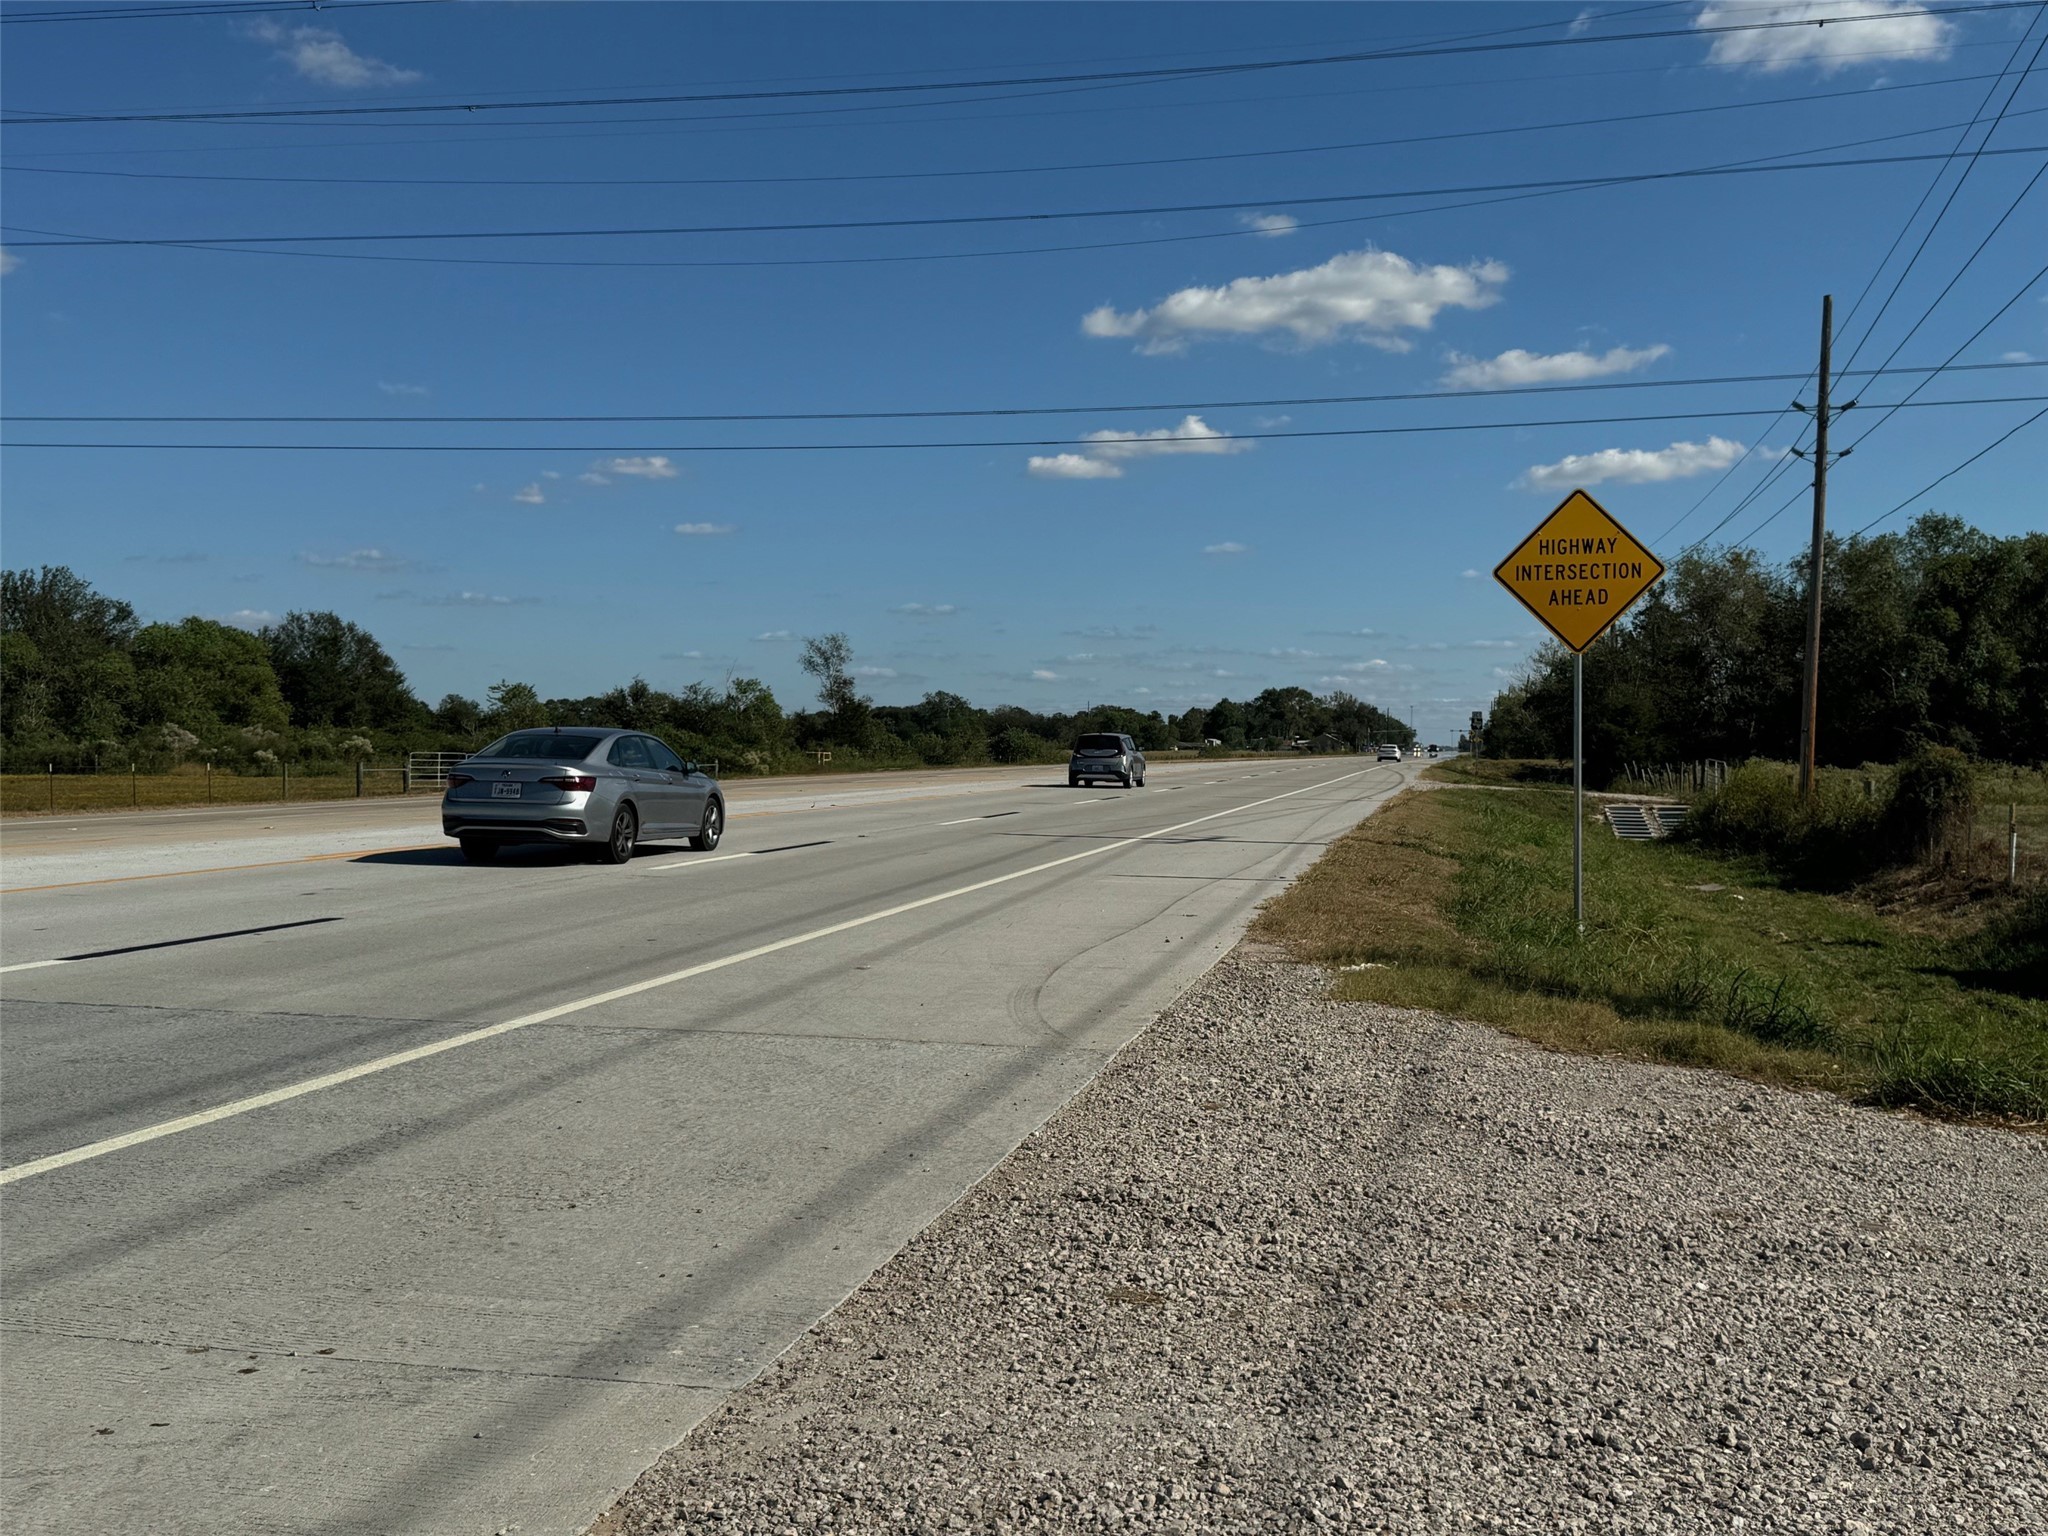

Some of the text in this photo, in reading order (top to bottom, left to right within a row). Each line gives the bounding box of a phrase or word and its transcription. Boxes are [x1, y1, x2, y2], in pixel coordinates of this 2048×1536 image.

[1539, 537, 1618, 556] HIGHWAY
[1515, 562, 1642, 582] INTERSECTION
[1548, 588, 1609, 607] AHEAD
